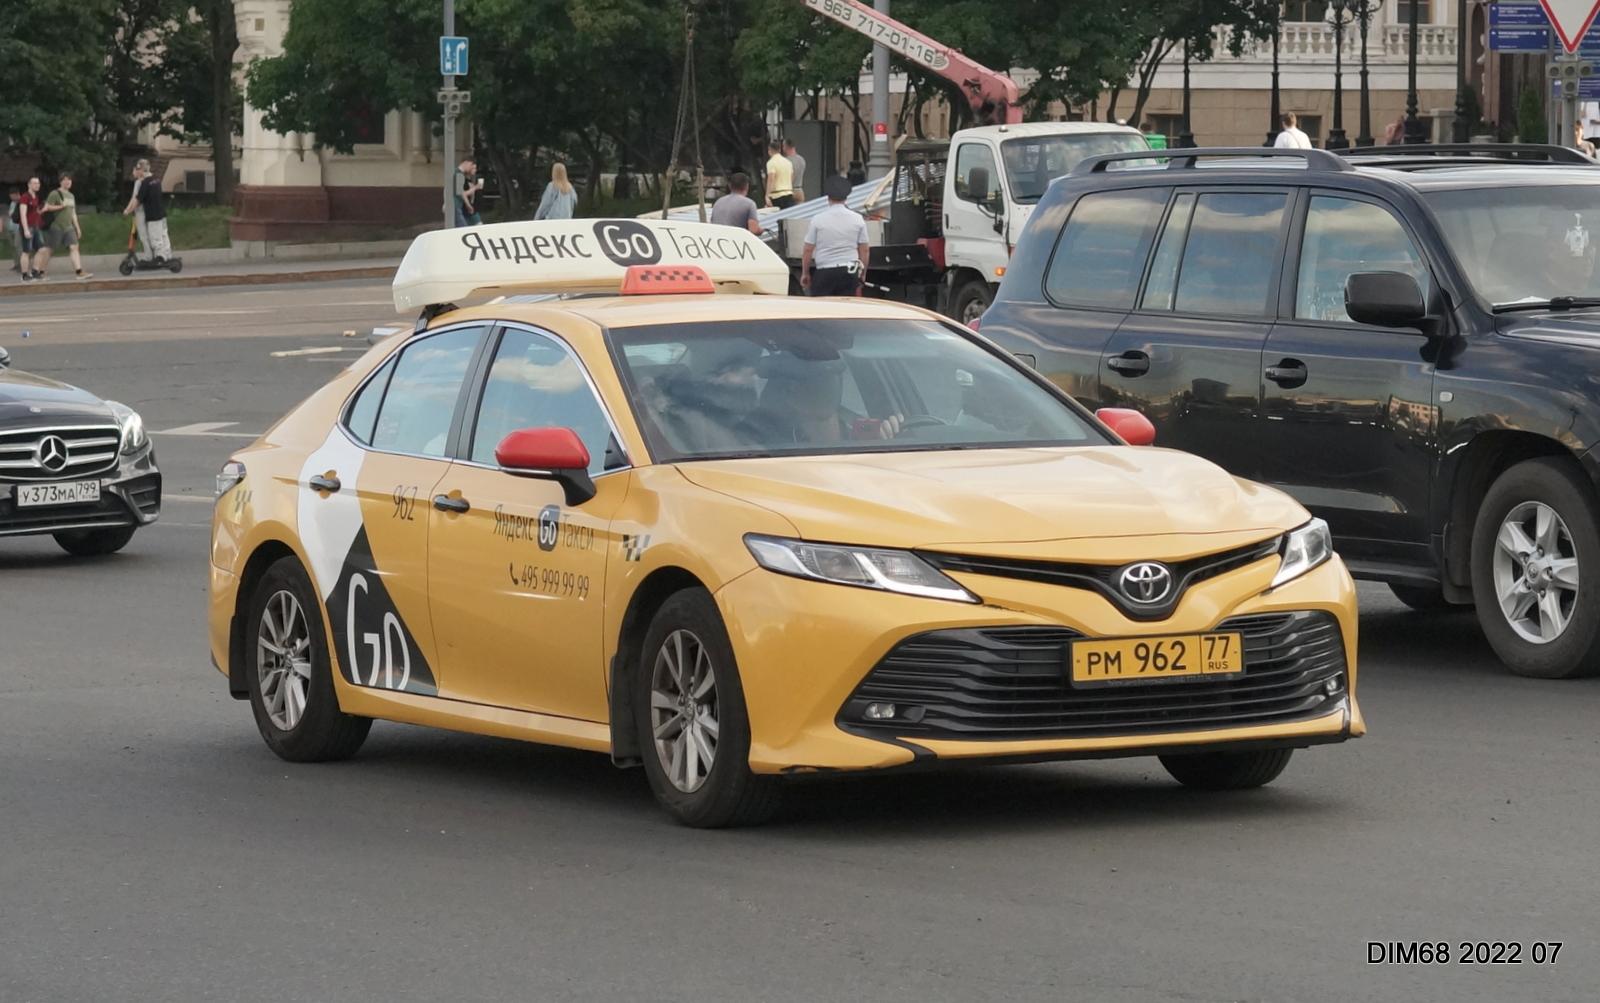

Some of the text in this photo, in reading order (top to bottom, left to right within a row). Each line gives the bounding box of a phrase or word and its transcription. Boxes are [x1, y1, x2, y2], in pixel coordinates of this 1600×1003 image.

[823, 0, 934, 64] 963 717-01-16
[461, 225, 755, 264] Яндекс Go Такси
[78, 483, 96, 495] 799
[392, 485, 418, 521] 962
[493, 504, 595, 550] Яндекс Go Такси
[521, 564, 590, 599] 495 999 99 99
[347, 573, 410, 690] Go
[1134, 640, 1186, 672] 962
[1204, 636, 1230, 660] 77
[1208, 661, 1228, 670] RUS
